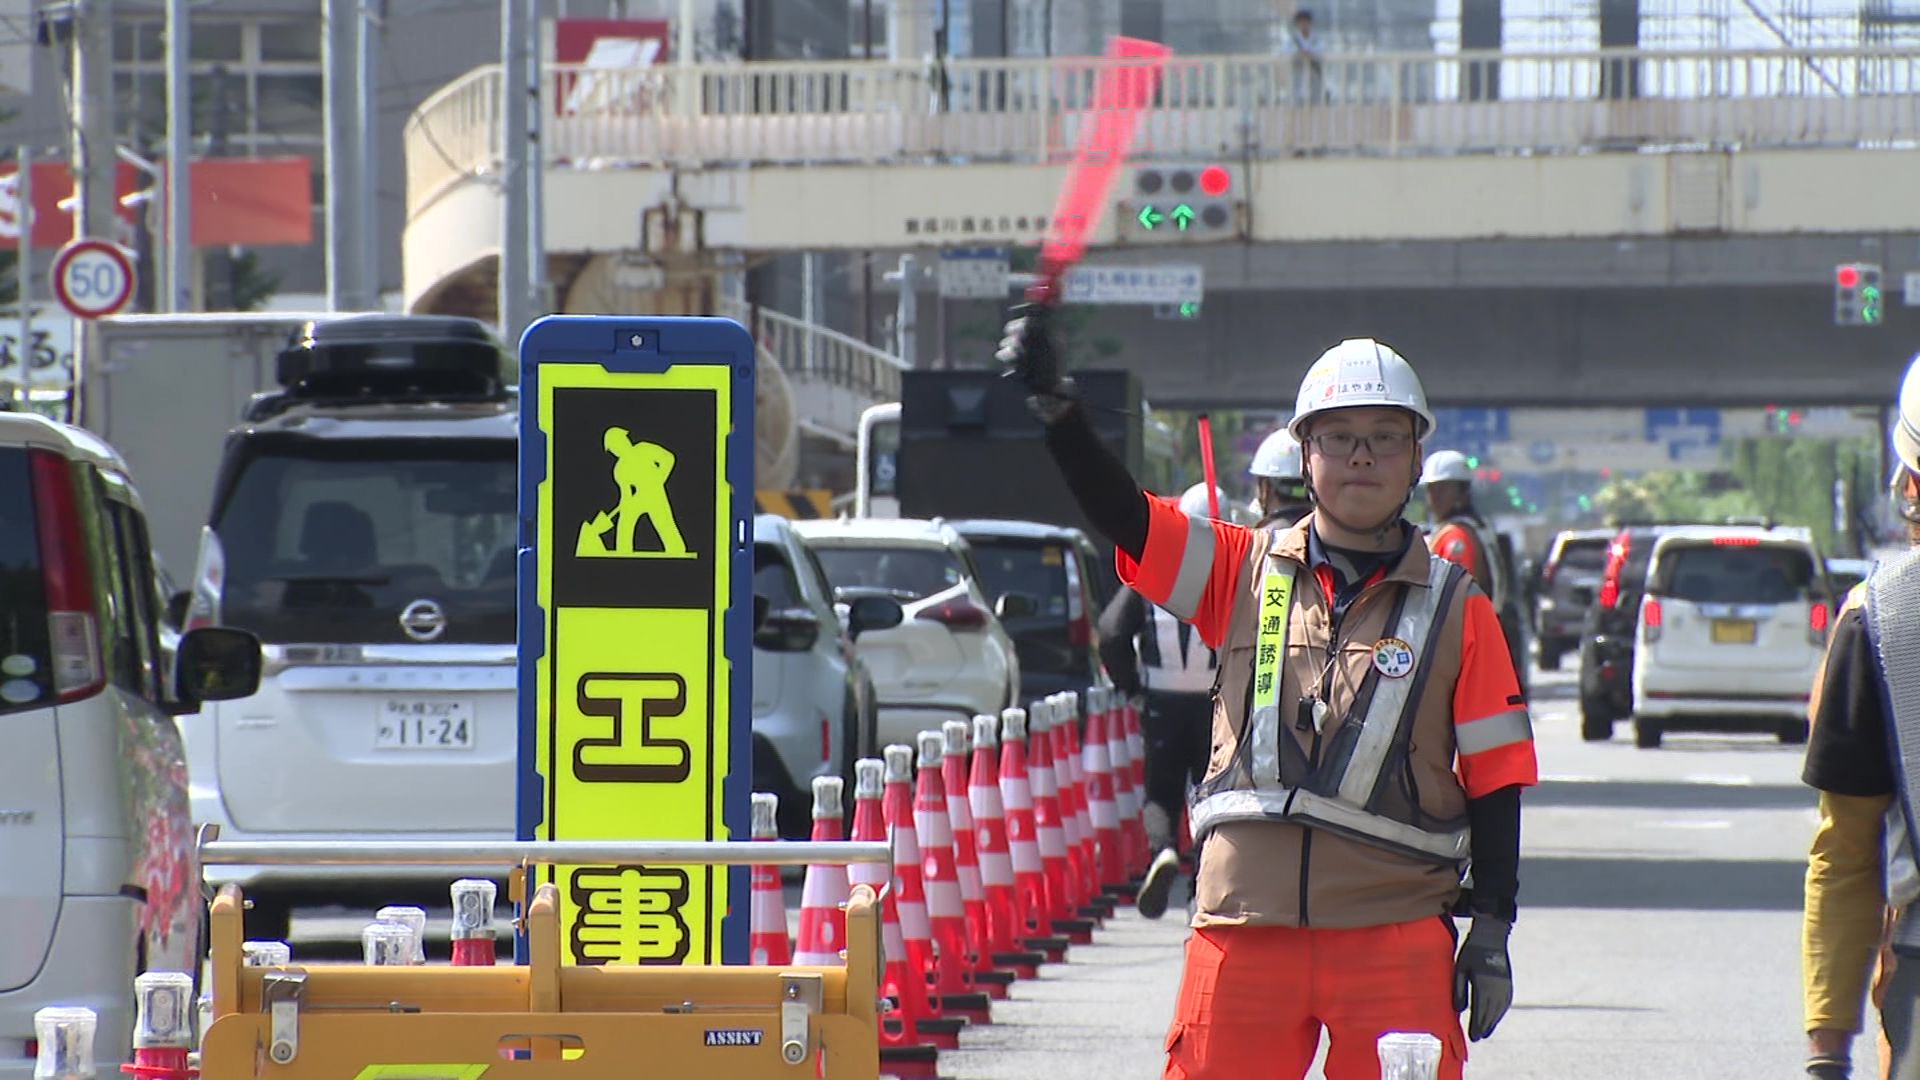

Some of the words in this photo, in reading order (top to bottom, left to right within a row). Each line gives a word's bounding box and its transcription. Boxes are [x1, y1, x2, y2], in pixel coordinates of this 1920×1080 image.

[71, 263, 116, 298] 50
[1257, 587, 1285, 694] 交通誘導
[399, 719, 468, 744] 11-24
[573, 672, 690, 966] 工事
[706, 1031, 762, 1045] ASSIST
